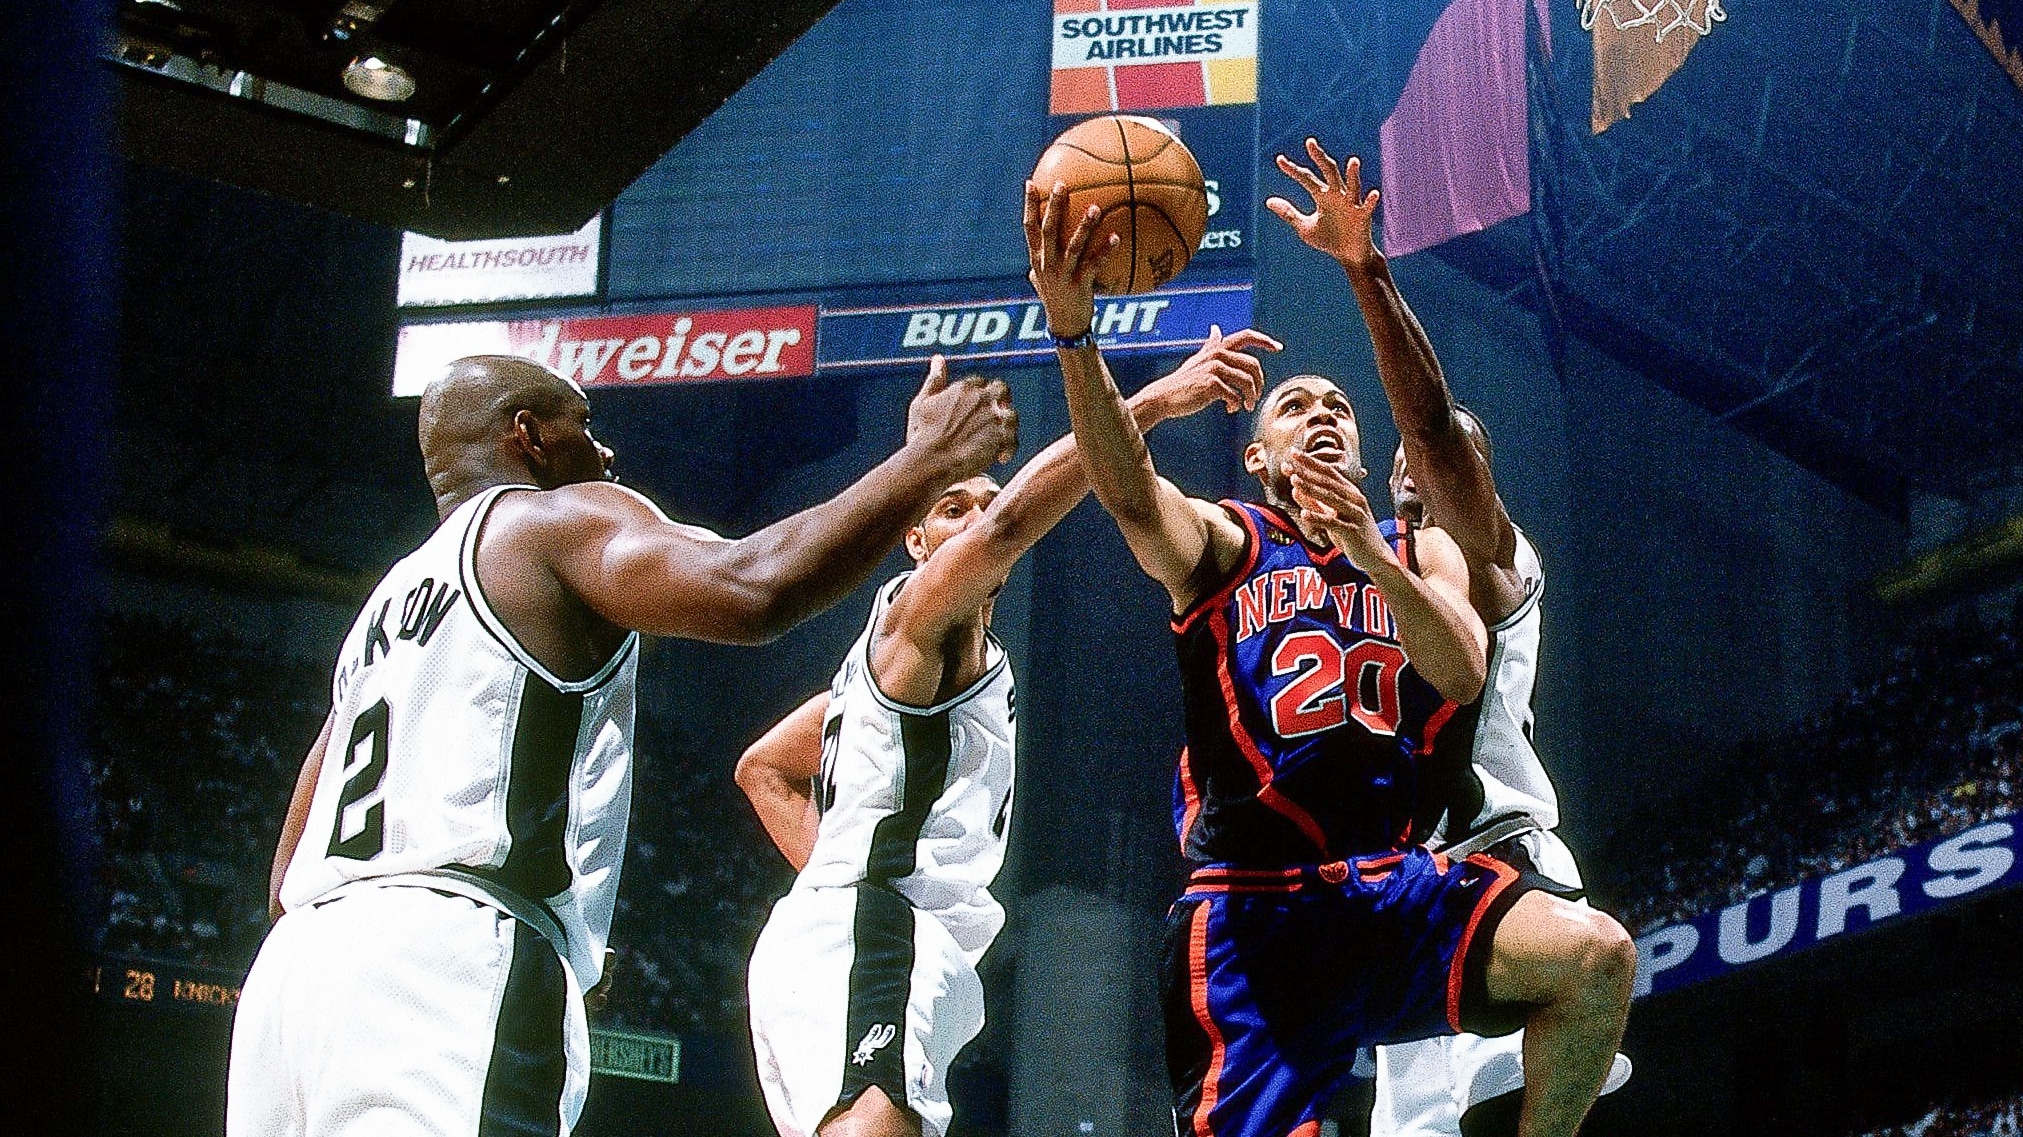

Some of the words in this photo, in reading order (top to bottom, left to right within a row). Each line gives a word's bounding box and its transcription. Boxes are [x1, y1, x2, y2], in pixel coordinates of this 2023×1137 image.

[1062, 8, 1250, 39] SOUTHWEST
[1086, 33, 1223, 61] AIRLINES
[407, 245, 590, 274] HEALTHSOUTH
[902, 310, 1012, 348] BUD
[1018, 299, 1170, 341] LHT
[1235, 566, 1328, 643] NEW
[1329, 583, 1401, 642] YO
[1271, 630, 1411, 739] 20
[325, 696, 392, 862] 2
[1633, 821, 2015, 1000] PURS
[122, 969, 156, 1002] 28
